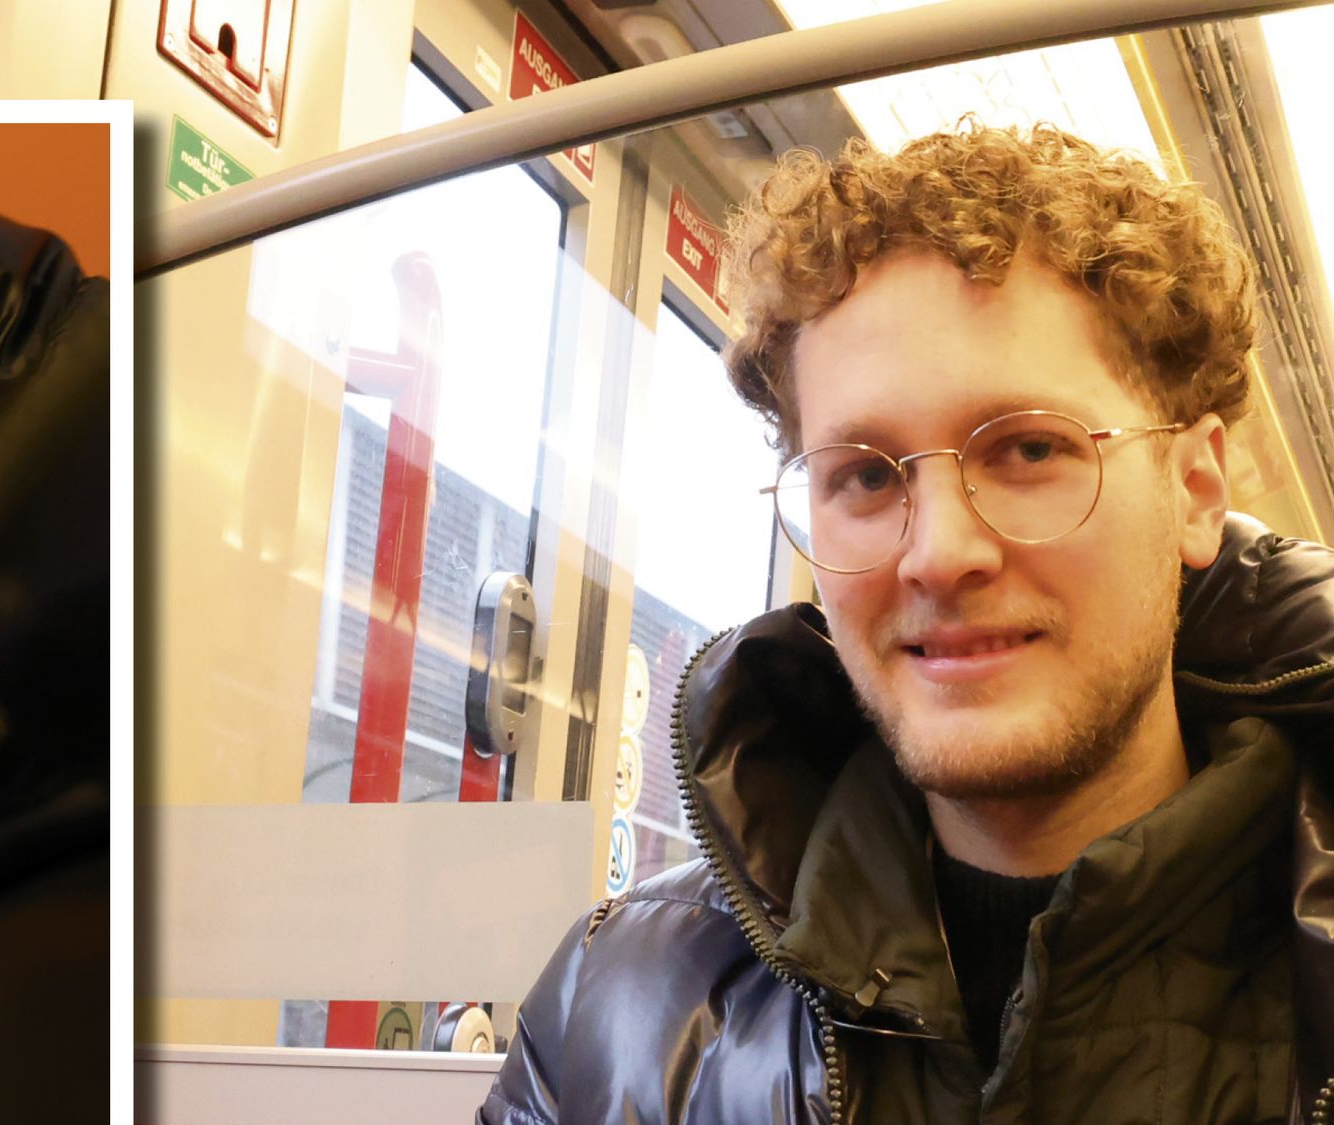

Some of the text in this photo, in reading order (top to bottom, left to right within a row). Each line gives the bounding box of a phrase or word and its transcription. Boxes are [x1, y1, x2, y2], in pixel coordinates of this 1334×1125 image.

[519, 37, 567, 91] AUSGA
[673, 200, 716, 257] AUSGANG
[682, 237, 703, 271] EXIT
